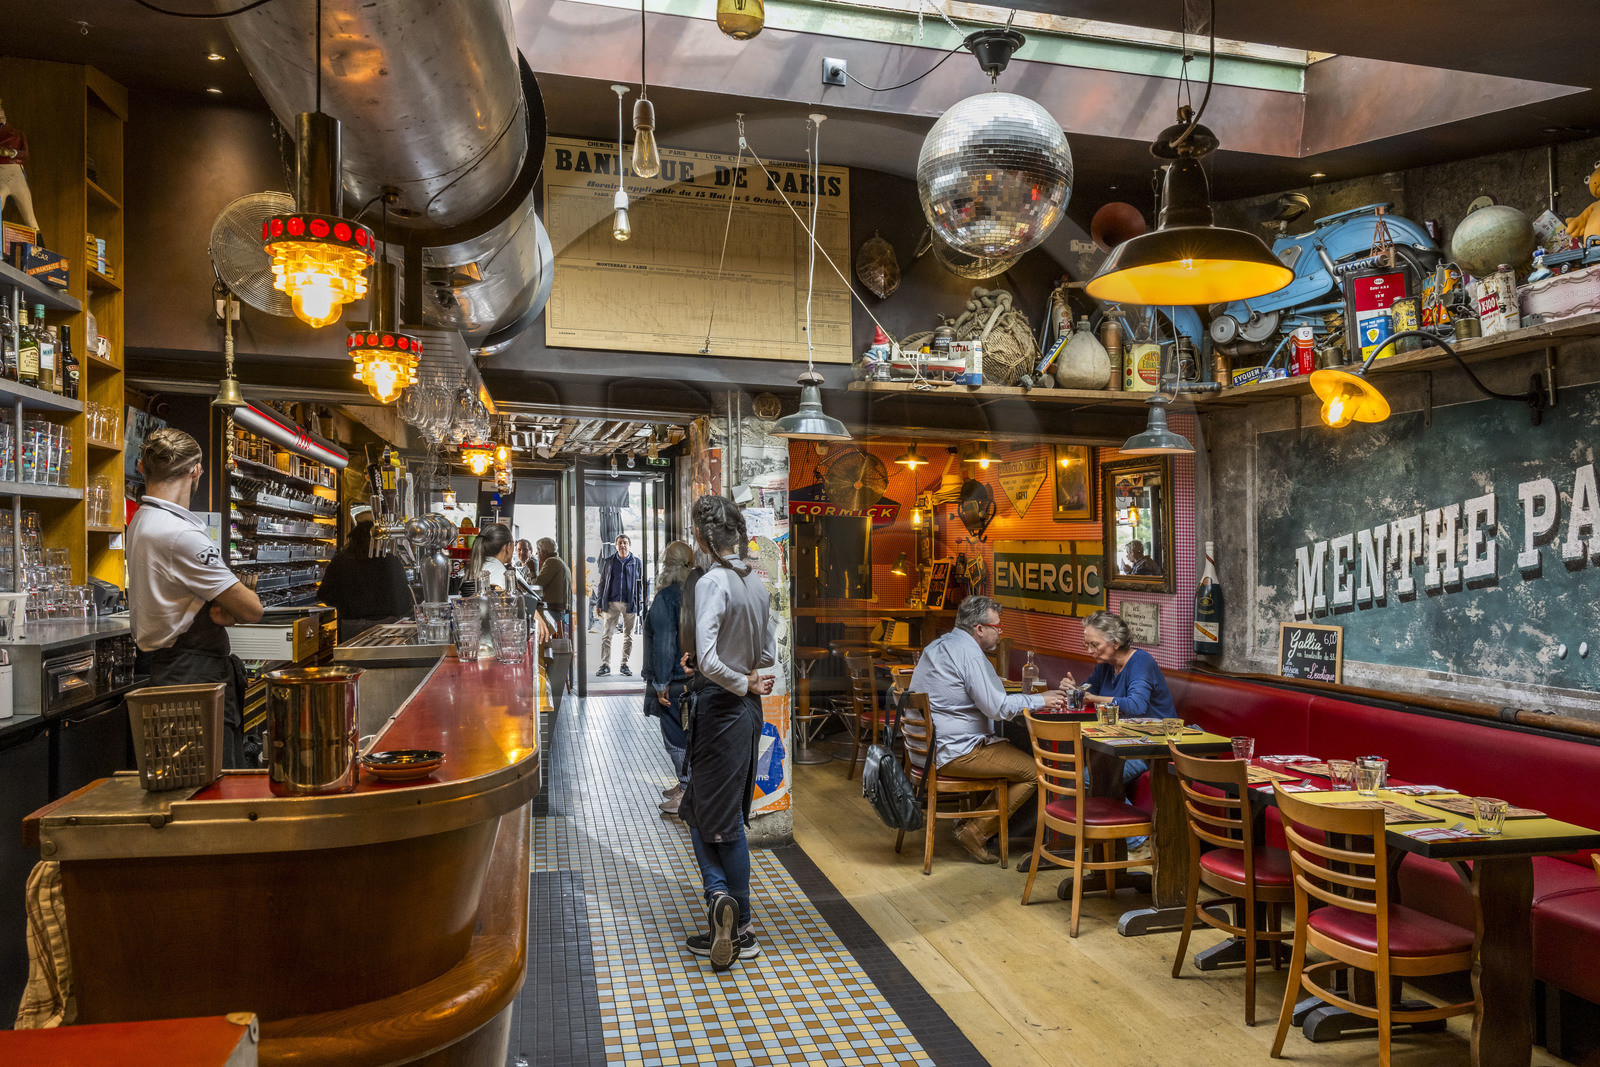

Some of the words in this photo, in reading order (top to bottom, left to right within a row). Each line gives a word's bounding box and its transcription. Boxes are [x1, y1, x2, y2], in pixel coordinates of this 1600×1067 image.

[587, 141, 613, 149] CHEMINS
[555, 148, 694, 184] BANLUE
[714, 164, 748, 189] DE
[767, 170, 842, 198] PARIS
[627, 185, 676, 196] applicable
[679, 189, 691, 197] du
[695, 190, 706, 198] 15
[951, 344, 971, 353] TOTAL
[1233, 367, 1261, 385] EYQUEM
[796, 504, 894, 519] CORMICK
[1293, 492, 1497, 617] MENTHE
[995, 560, 1100, 596] ENERGIC
[1288, 629, 1323, 659] Gallia
